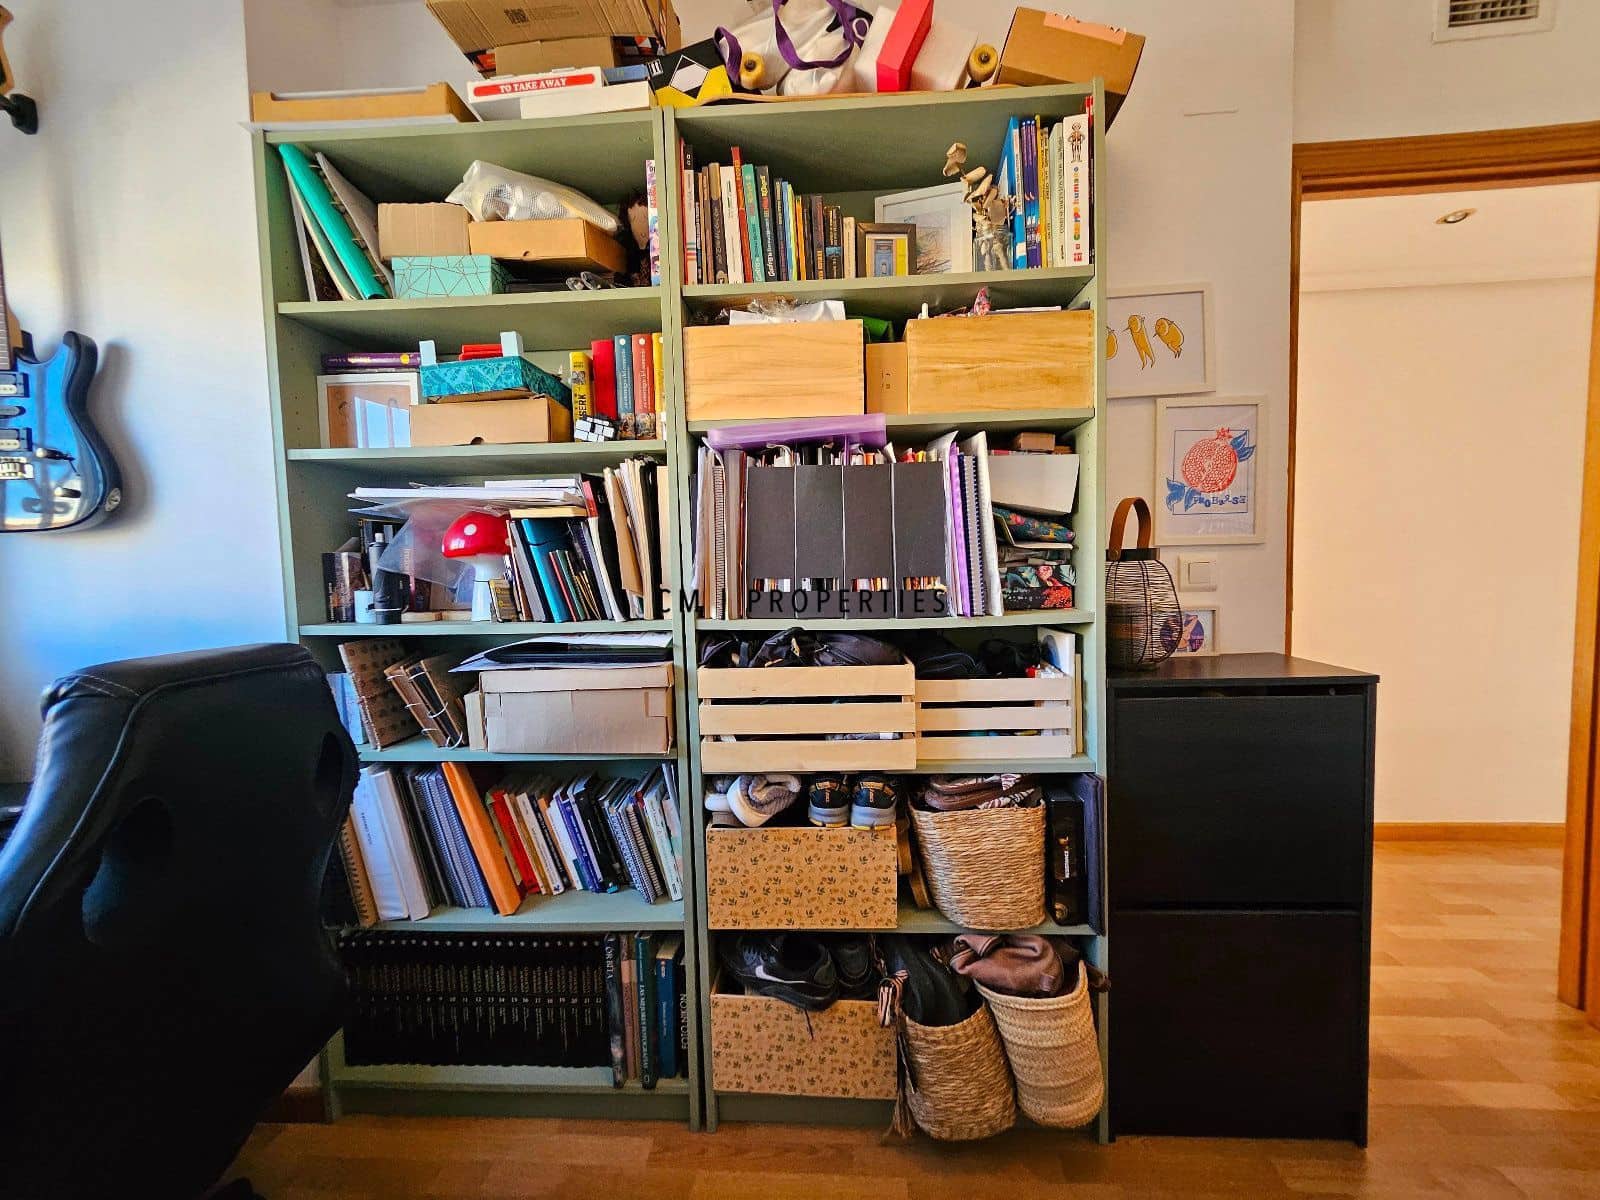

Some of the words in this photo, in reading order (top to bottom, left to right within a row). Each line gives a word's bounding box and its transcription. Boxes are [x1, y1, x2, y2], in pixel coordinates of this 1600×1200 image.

[499, 85, 512, 94] TO
[513, 81, 538, 93] TAKE
[539, 77, 567, 89] AWAY
